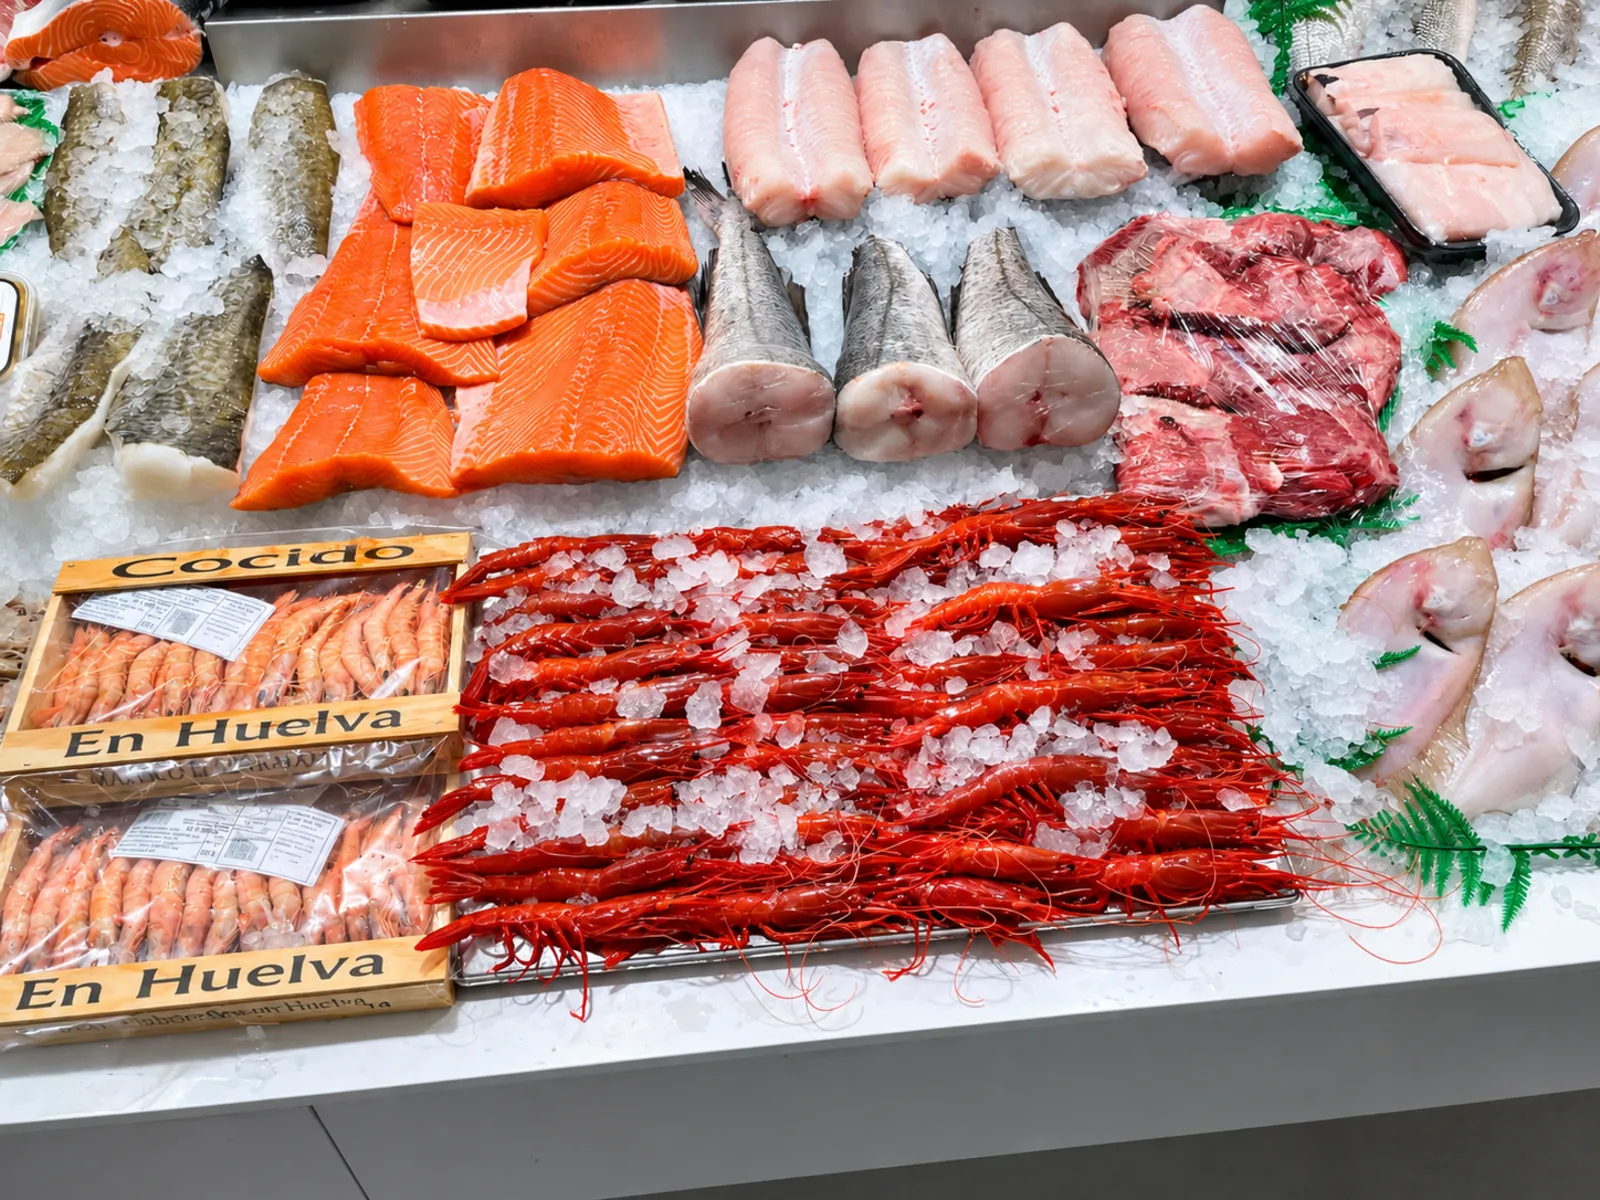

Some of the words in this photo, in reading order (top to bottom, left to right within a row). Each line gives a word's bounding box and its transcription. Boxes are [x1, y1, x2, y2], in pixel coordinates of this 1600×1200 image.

[112, 544, 415, 578] Cocido
[64, 729, 144, 758] En
[175, 709, 402, 747] Huelva
[16, 977, 103, 1010] En
[137, 954, 384, 999] Huelva
